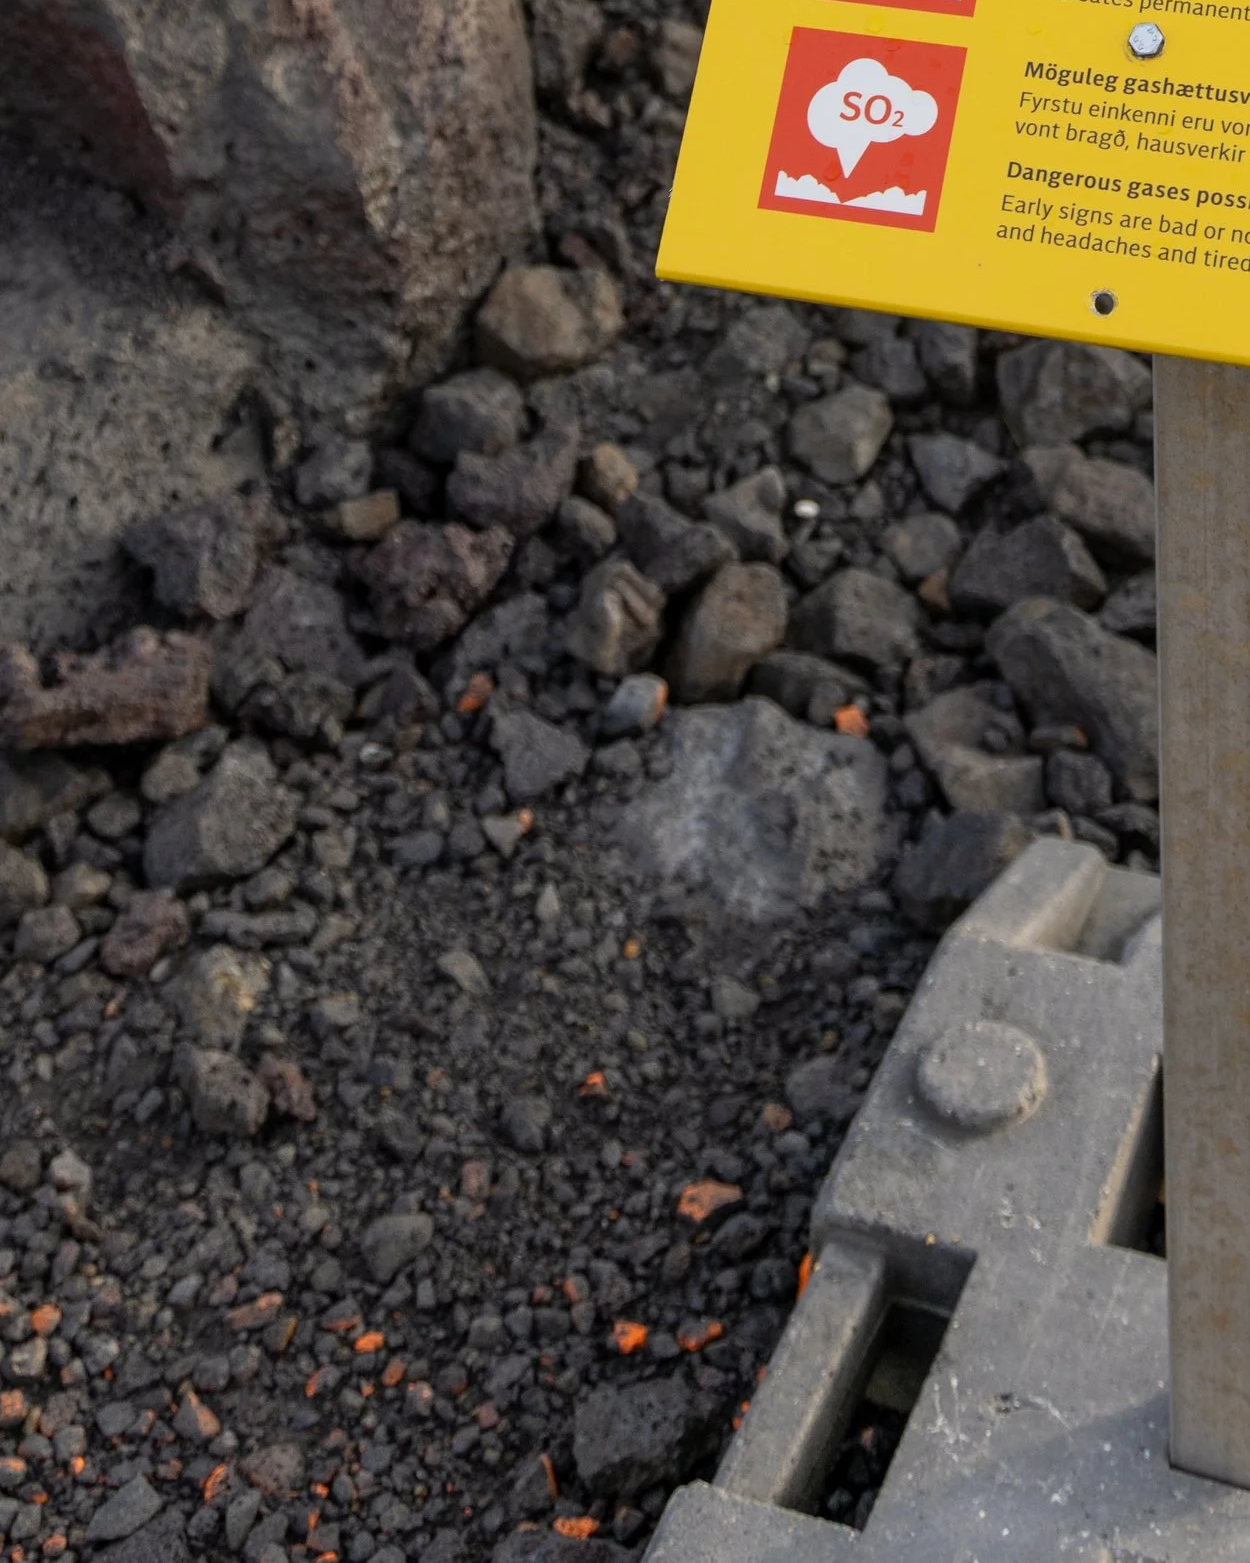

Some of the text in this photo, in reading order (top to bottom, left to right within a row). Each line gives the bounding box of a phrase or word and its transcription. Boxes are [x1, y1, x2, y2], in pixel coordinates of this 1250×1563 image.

[1024, 61, 1120, 93] Möguleg
[1019, 91, 1083, 116] Fyrstu
[1088, 100, 1177, 127] einkenni
[1181, 115, 1215, 132] eru
[1015, 120, 1061, 140] vont
[1065, 122, 1130, 151] bragð,
[1136, 131, 1247, 163] hausverkir
[1006, 161, 1122, 193] Dangerous
[1126, 181, 1191, 202] gases
[1001, 194, 1054, 221] Early
[1058, 202, 1114, 227] signs
[1119, 214, 1153, 231] are
[1158, 214, 1199, 237] bad
[1203, 225, 1226, 241] or
[996, 223, 1036, 243] and
[1040, 225, 1152, 259] headaches
[1157, 246, 1198, 265] and
